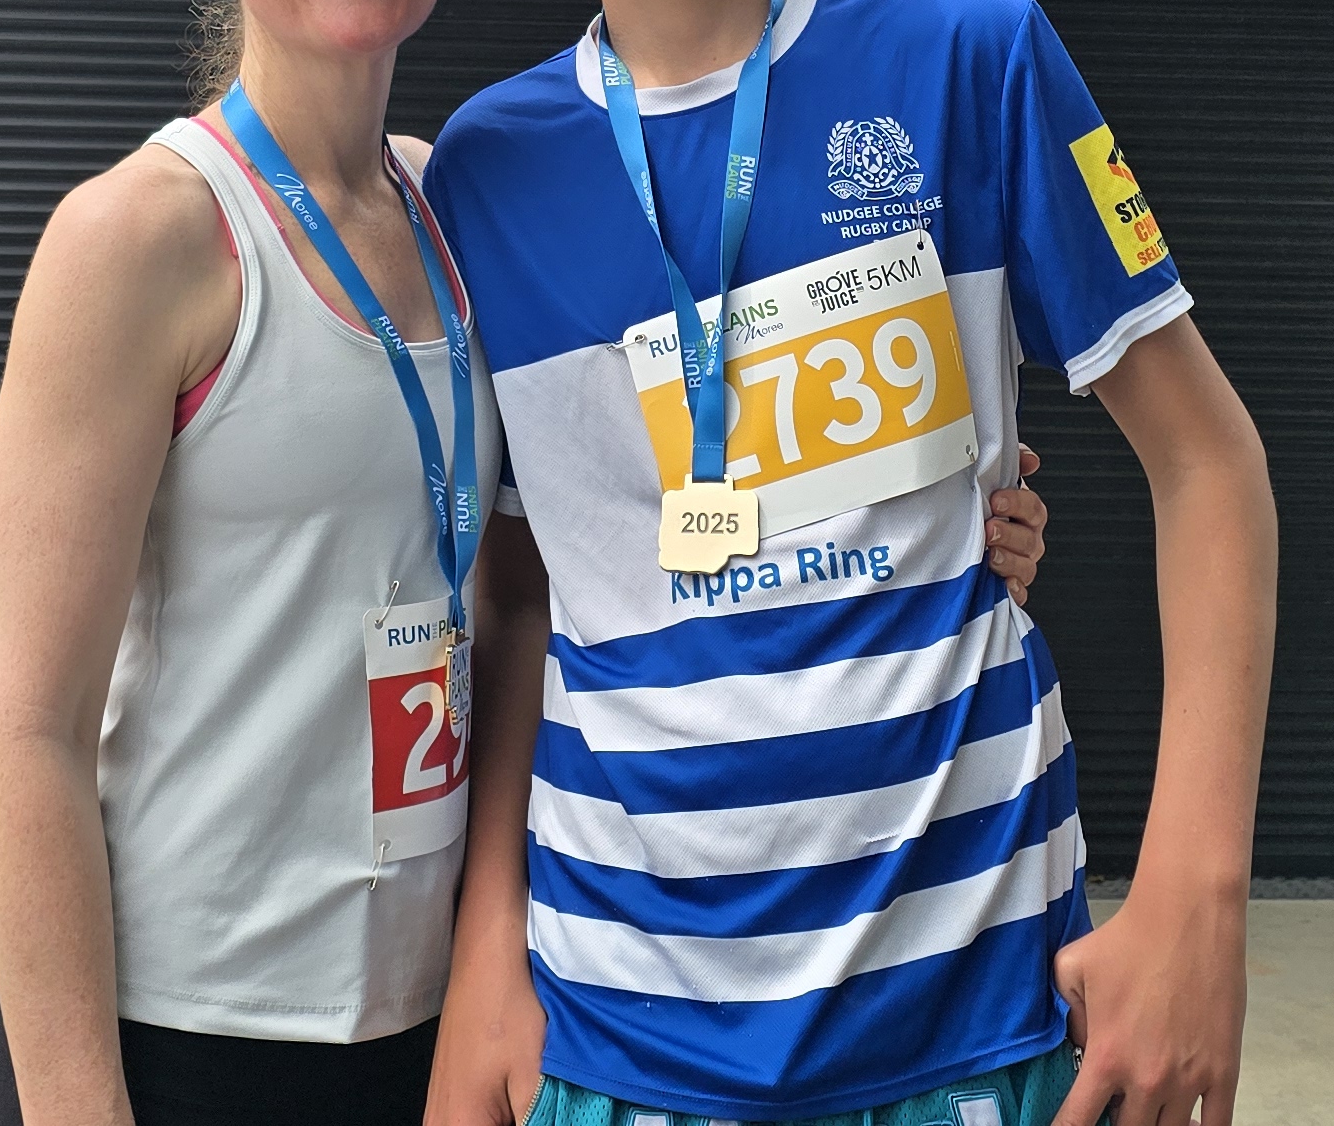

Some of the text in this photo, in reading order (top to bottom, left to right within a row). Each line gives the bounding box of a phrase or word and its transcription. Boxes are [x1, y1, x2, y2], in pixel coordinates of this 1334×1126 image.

[602, 55, 620, 86] RUN
[725, 153, 741, 200] PLAINS
[737, 155, 756, 196] RUN
[274, 173, 318, 231] Moree
[821, 196, 944, 224] NUDGEE COLLEGE
[841, 217, 932, 238] RUGBY CAMP
[866, 255, 922, 290] 5KM
[819, 289, 859, 314] JUICE
[378, 315, 405, 350] RUN
[451, 313, 470, 378] Moree
[648, 298, 779, 359] RU PAINS
[735, 322, 784, 345] Moree
[684, 349, 702, 389] RUN
[428, 463, 448, 535] Moree
[456, 492, 470, 533] RUN
[468, 485, 478, 533] PLAINS
[681, 511, 740, 534] 2025
[796, 541, 895, 584] Ring
[387, 623, 431, 647] RUN
